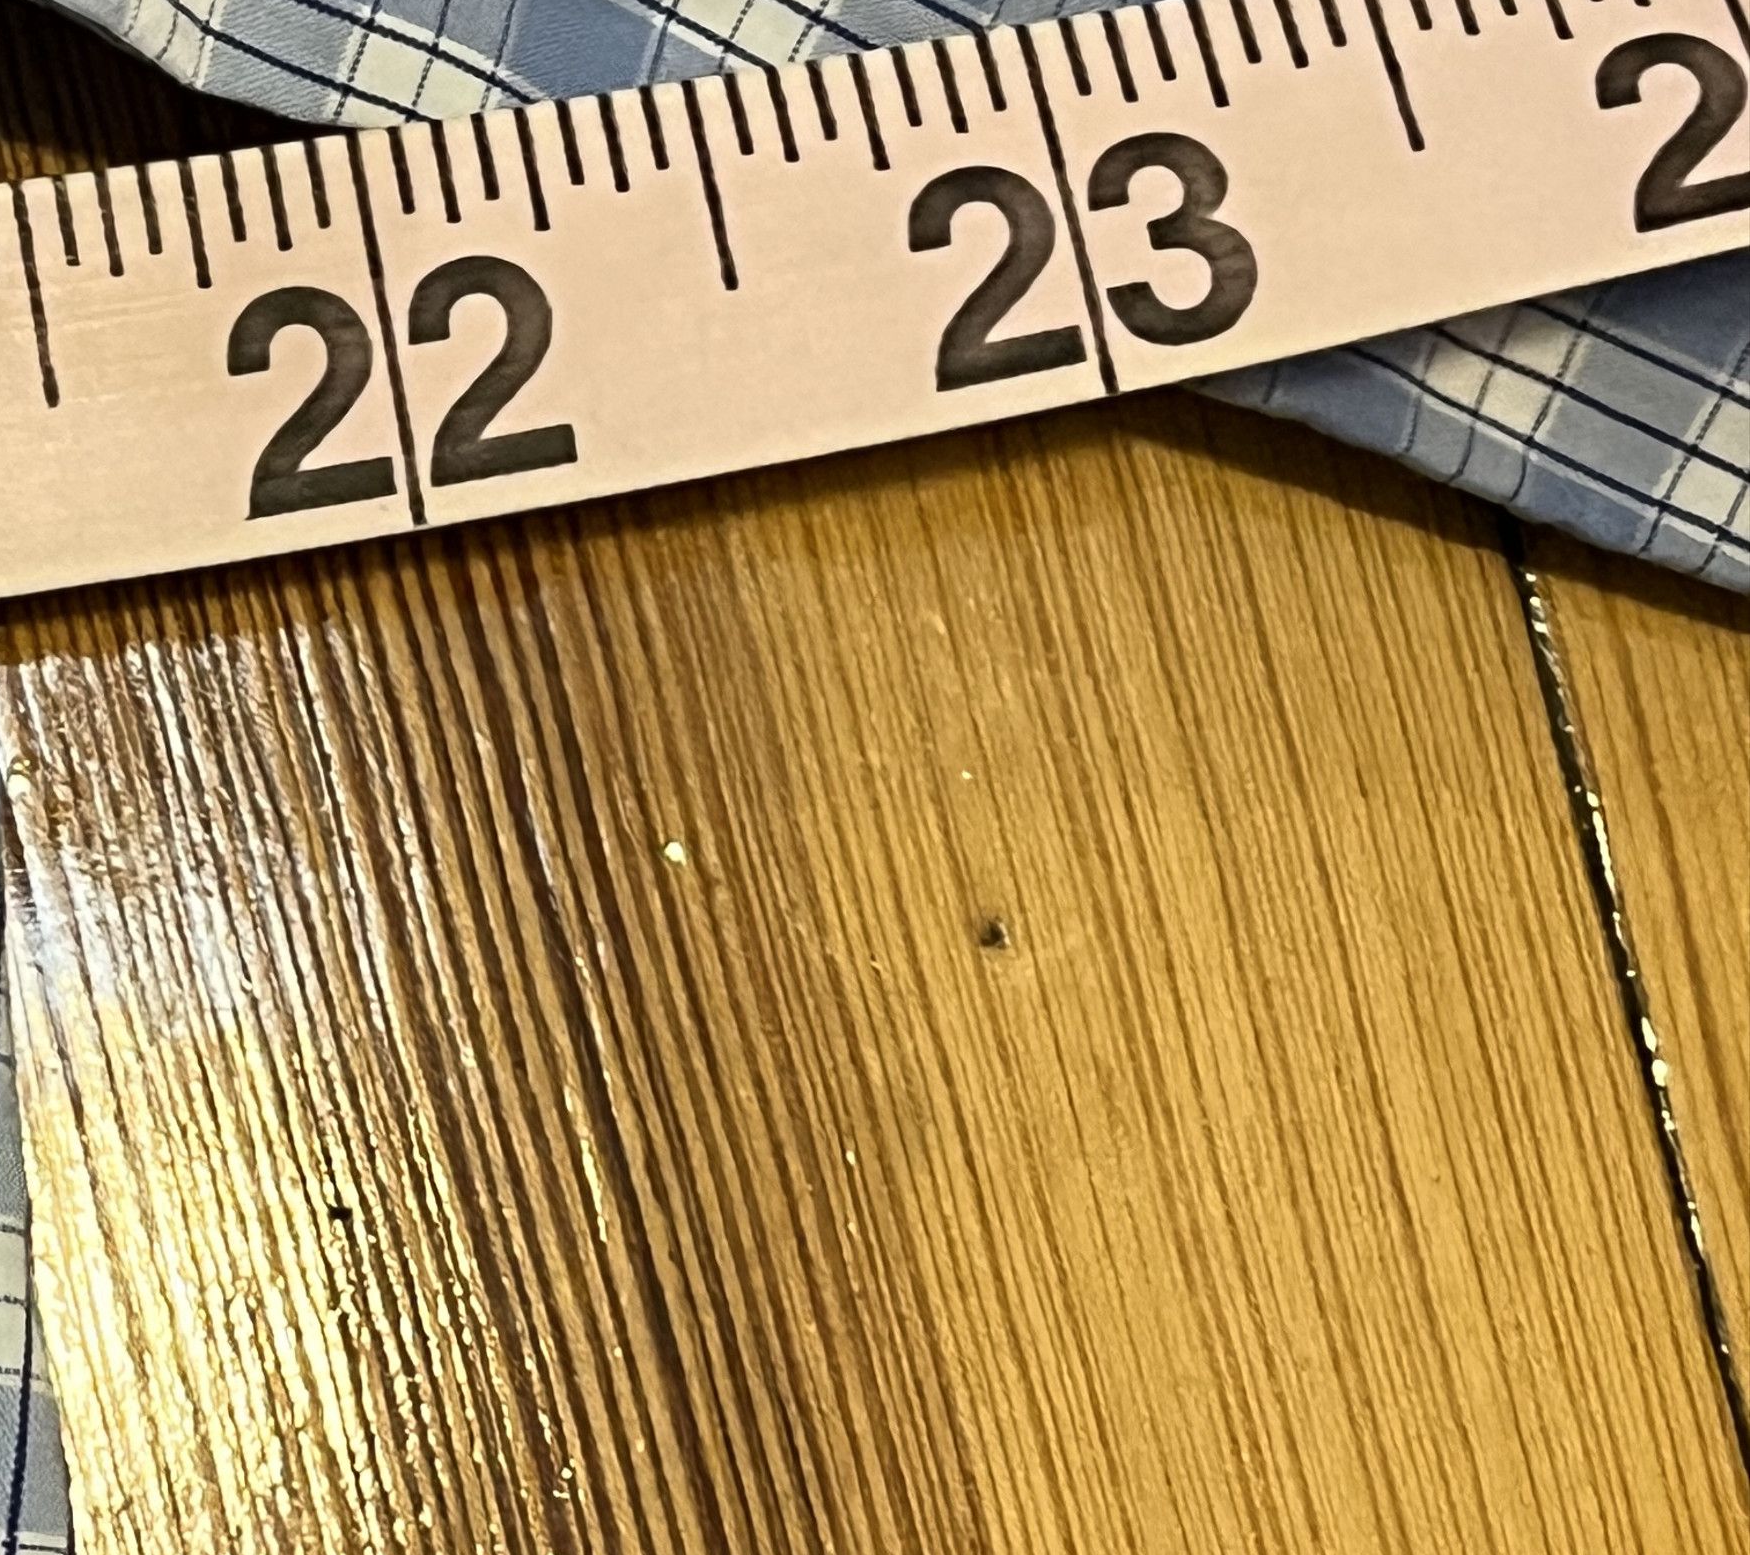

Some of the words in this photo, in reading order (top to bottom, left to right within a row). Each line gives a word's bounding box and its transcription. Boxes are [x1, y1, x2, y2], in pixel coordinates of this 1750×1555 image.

[228, 256, 578, 517] 22
[907, 131, 1259, 392] 23
[1595, 33, 1750, 233] 2
